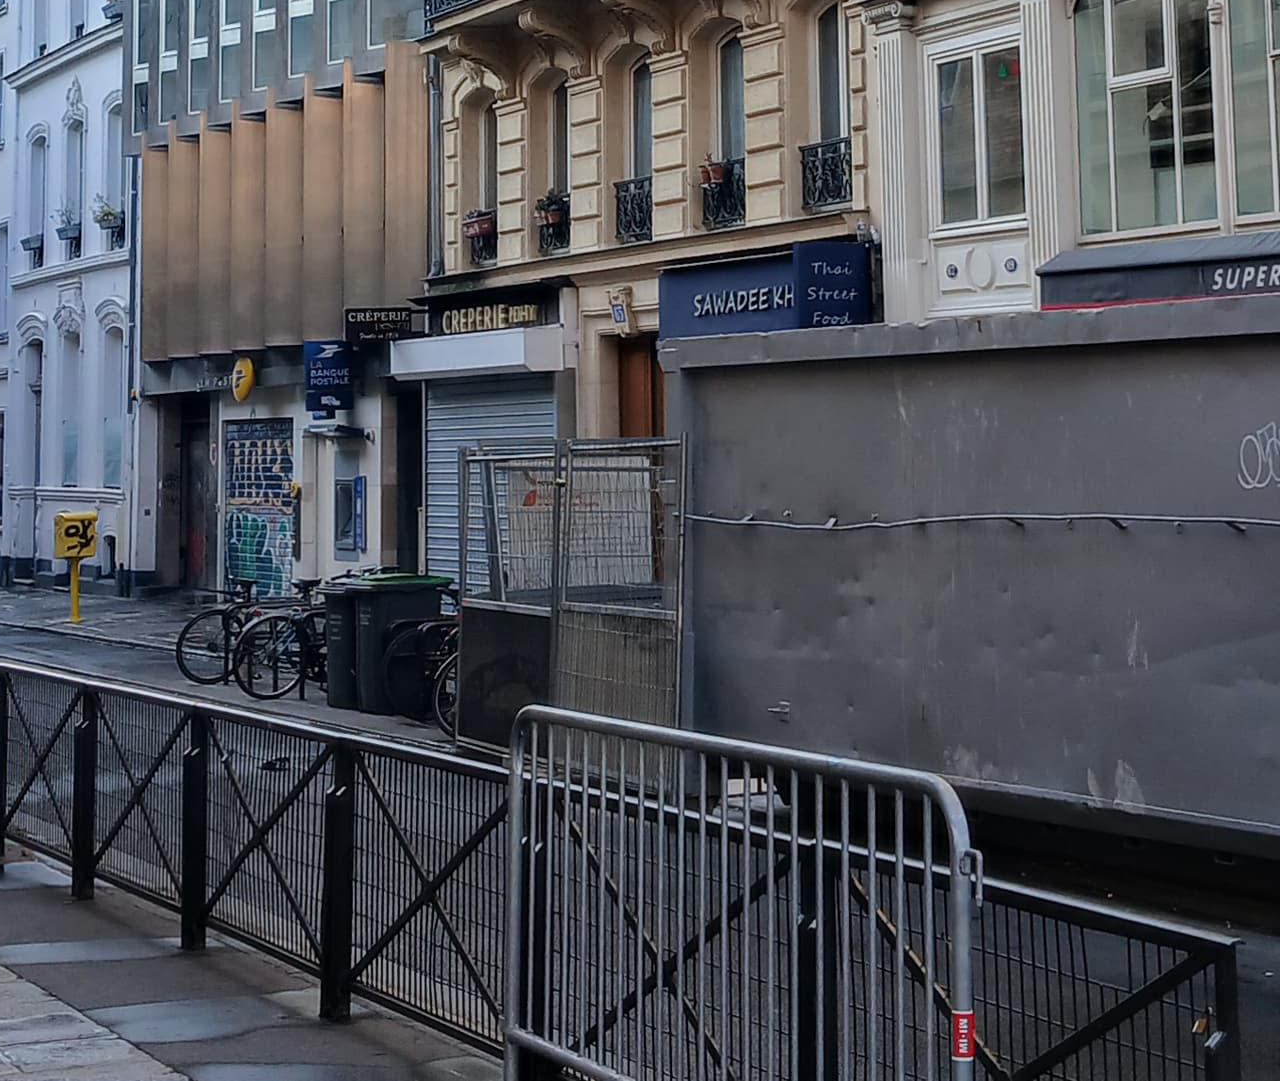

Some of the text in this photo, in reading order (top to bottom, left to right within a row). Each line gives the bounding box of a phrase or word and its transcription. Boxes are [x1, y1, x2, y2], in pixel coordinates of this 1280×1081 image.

[811, 262, 852, 275] Thai
[807, 286, 858, 301] Street
[693, 287, 769, 317] SAWADEE
[442, 304, 508, 334] CREPERIE
[812, 311, 852, 325] Food
[310, 368, 351, 377] BANQUE
[310, 376, 351, 386] POSTALE
